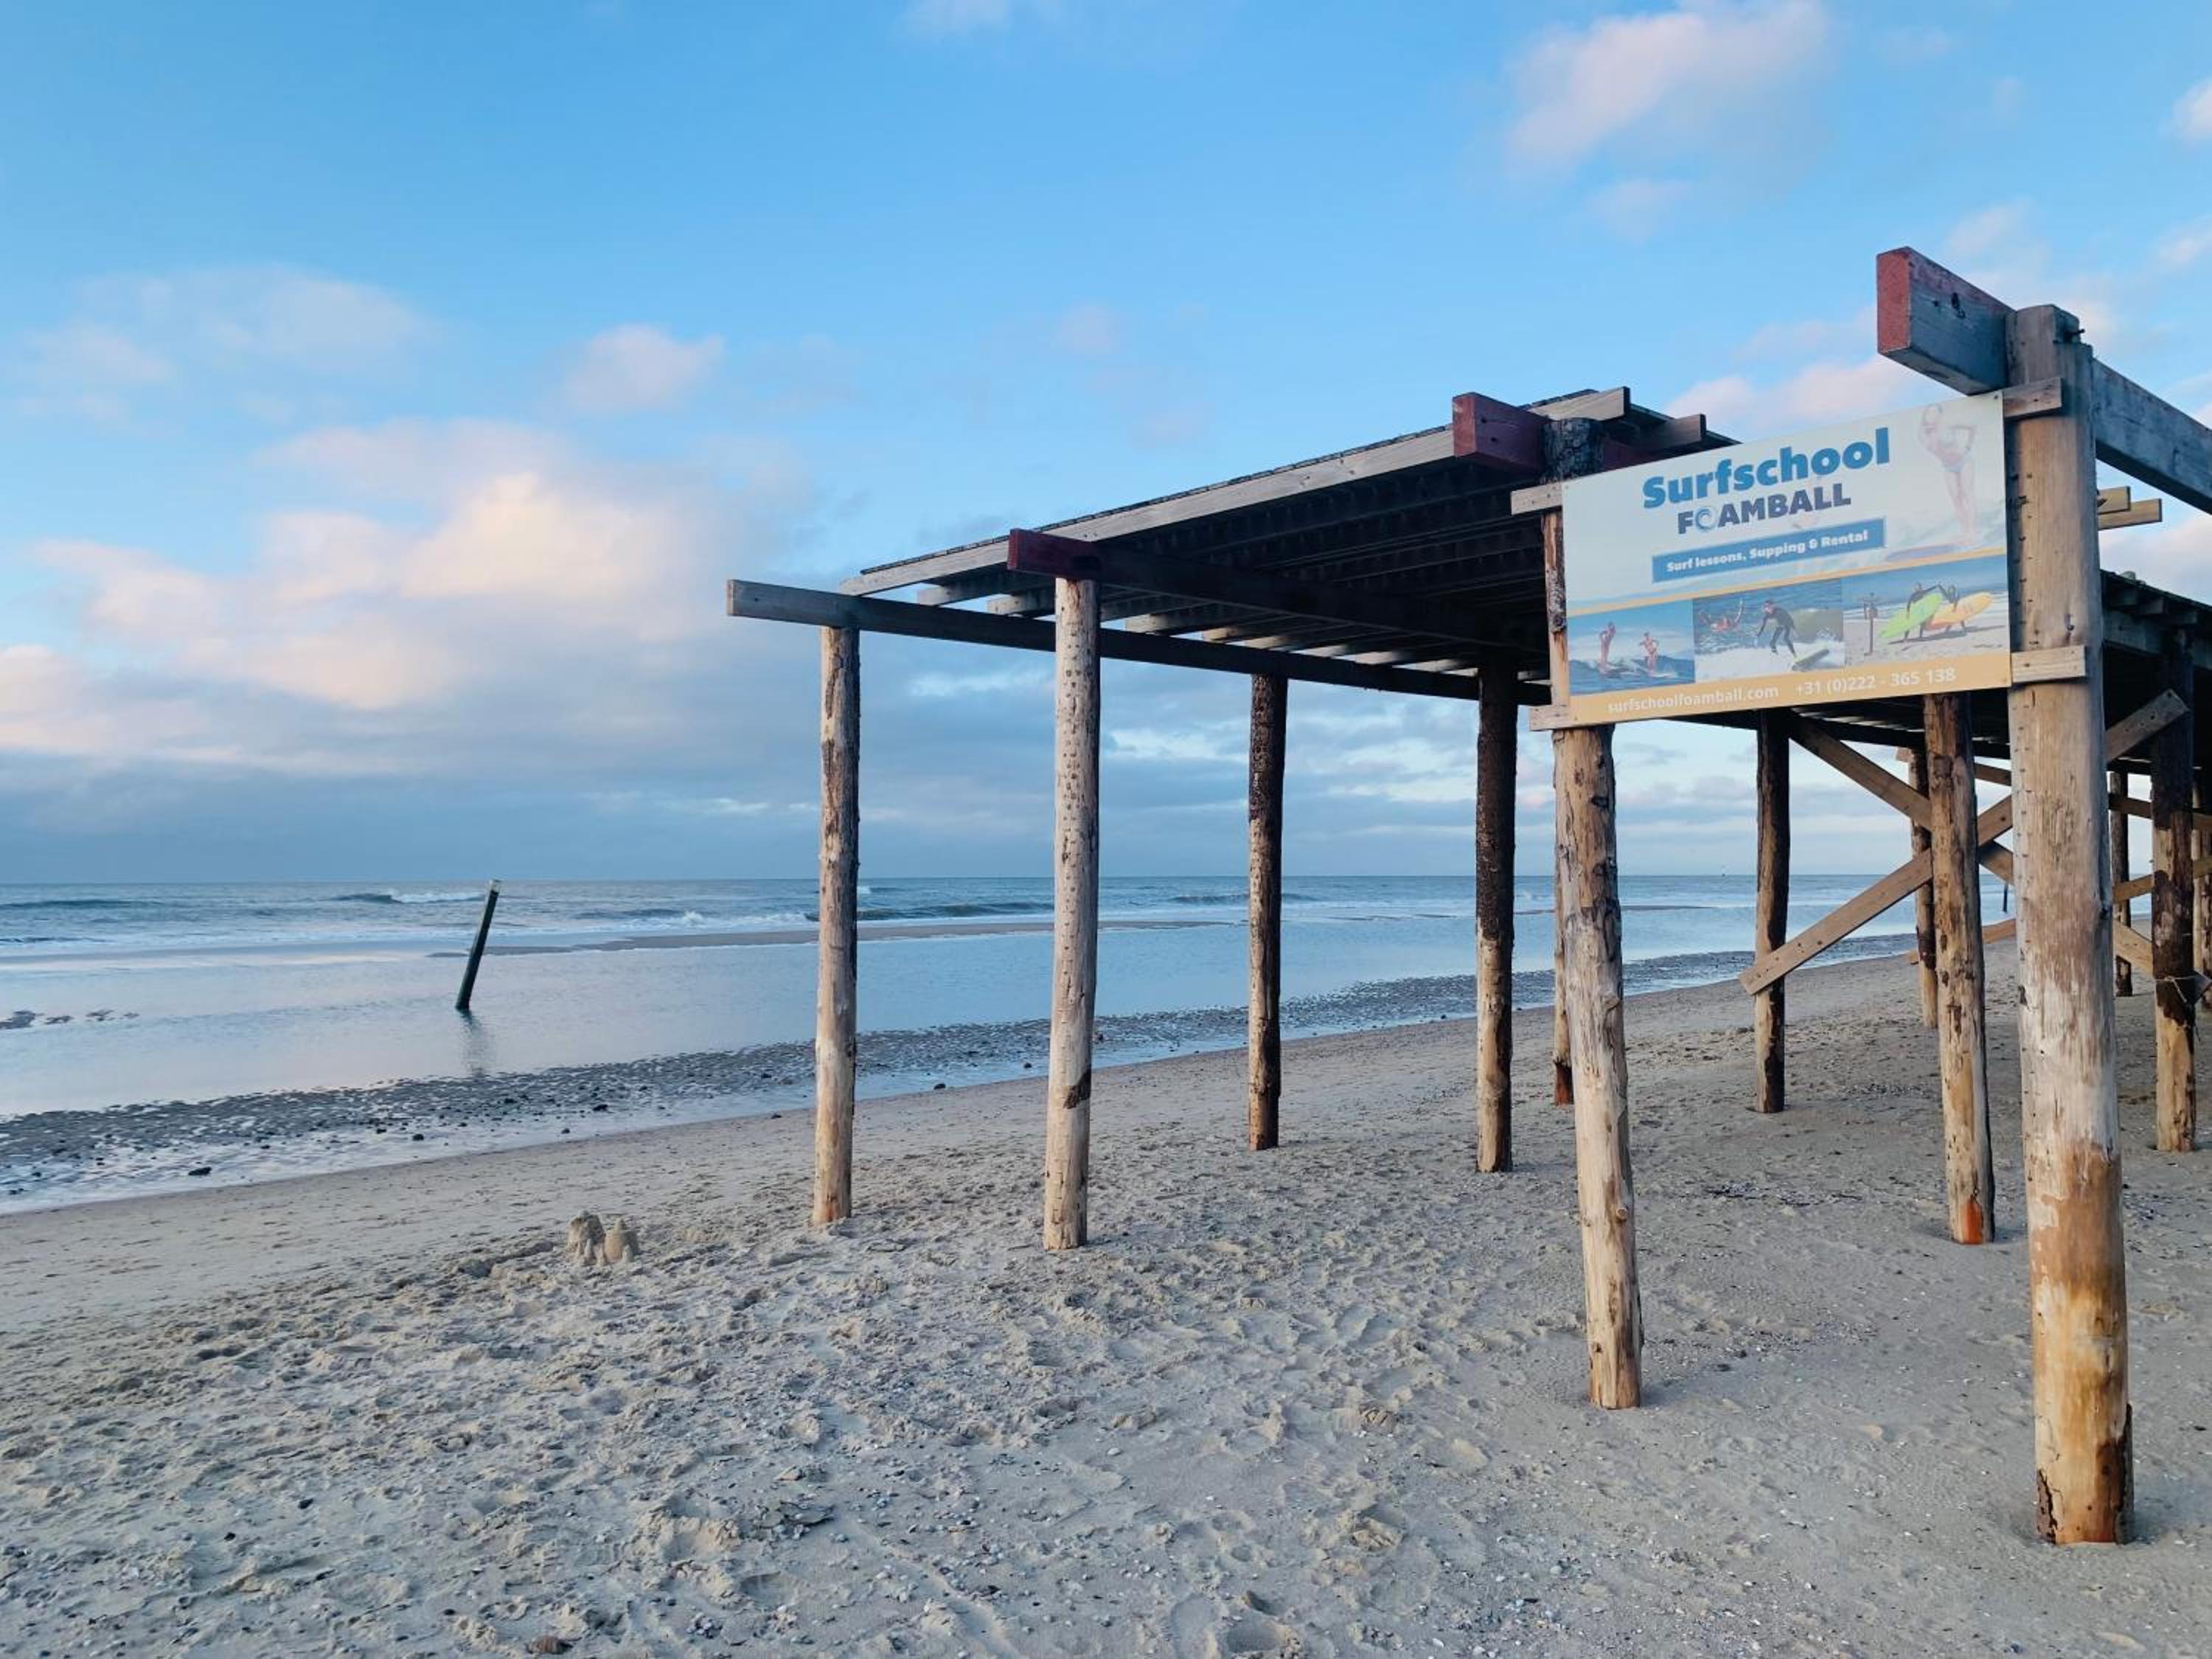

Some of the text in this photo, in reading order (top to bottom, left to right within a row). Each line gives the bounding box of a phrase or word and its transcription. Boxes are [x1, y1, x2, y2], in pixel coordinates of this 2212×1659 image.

[1643, 427, 1890, 509] Surfschool
[1677, 483, 1851, 535] FOAMBALL
[1666, 529, 1868, 572] Surf lessons, Supping & Rental
[1607, 686, 1779, 714] surfschoolfoamball.com
[1796, 680, 1820, 695] +31
[1826, 675, 1876, 695] (0)222
[1891, 671, 1921, 687] 365
[1926, 667, 1956, 685] 138
